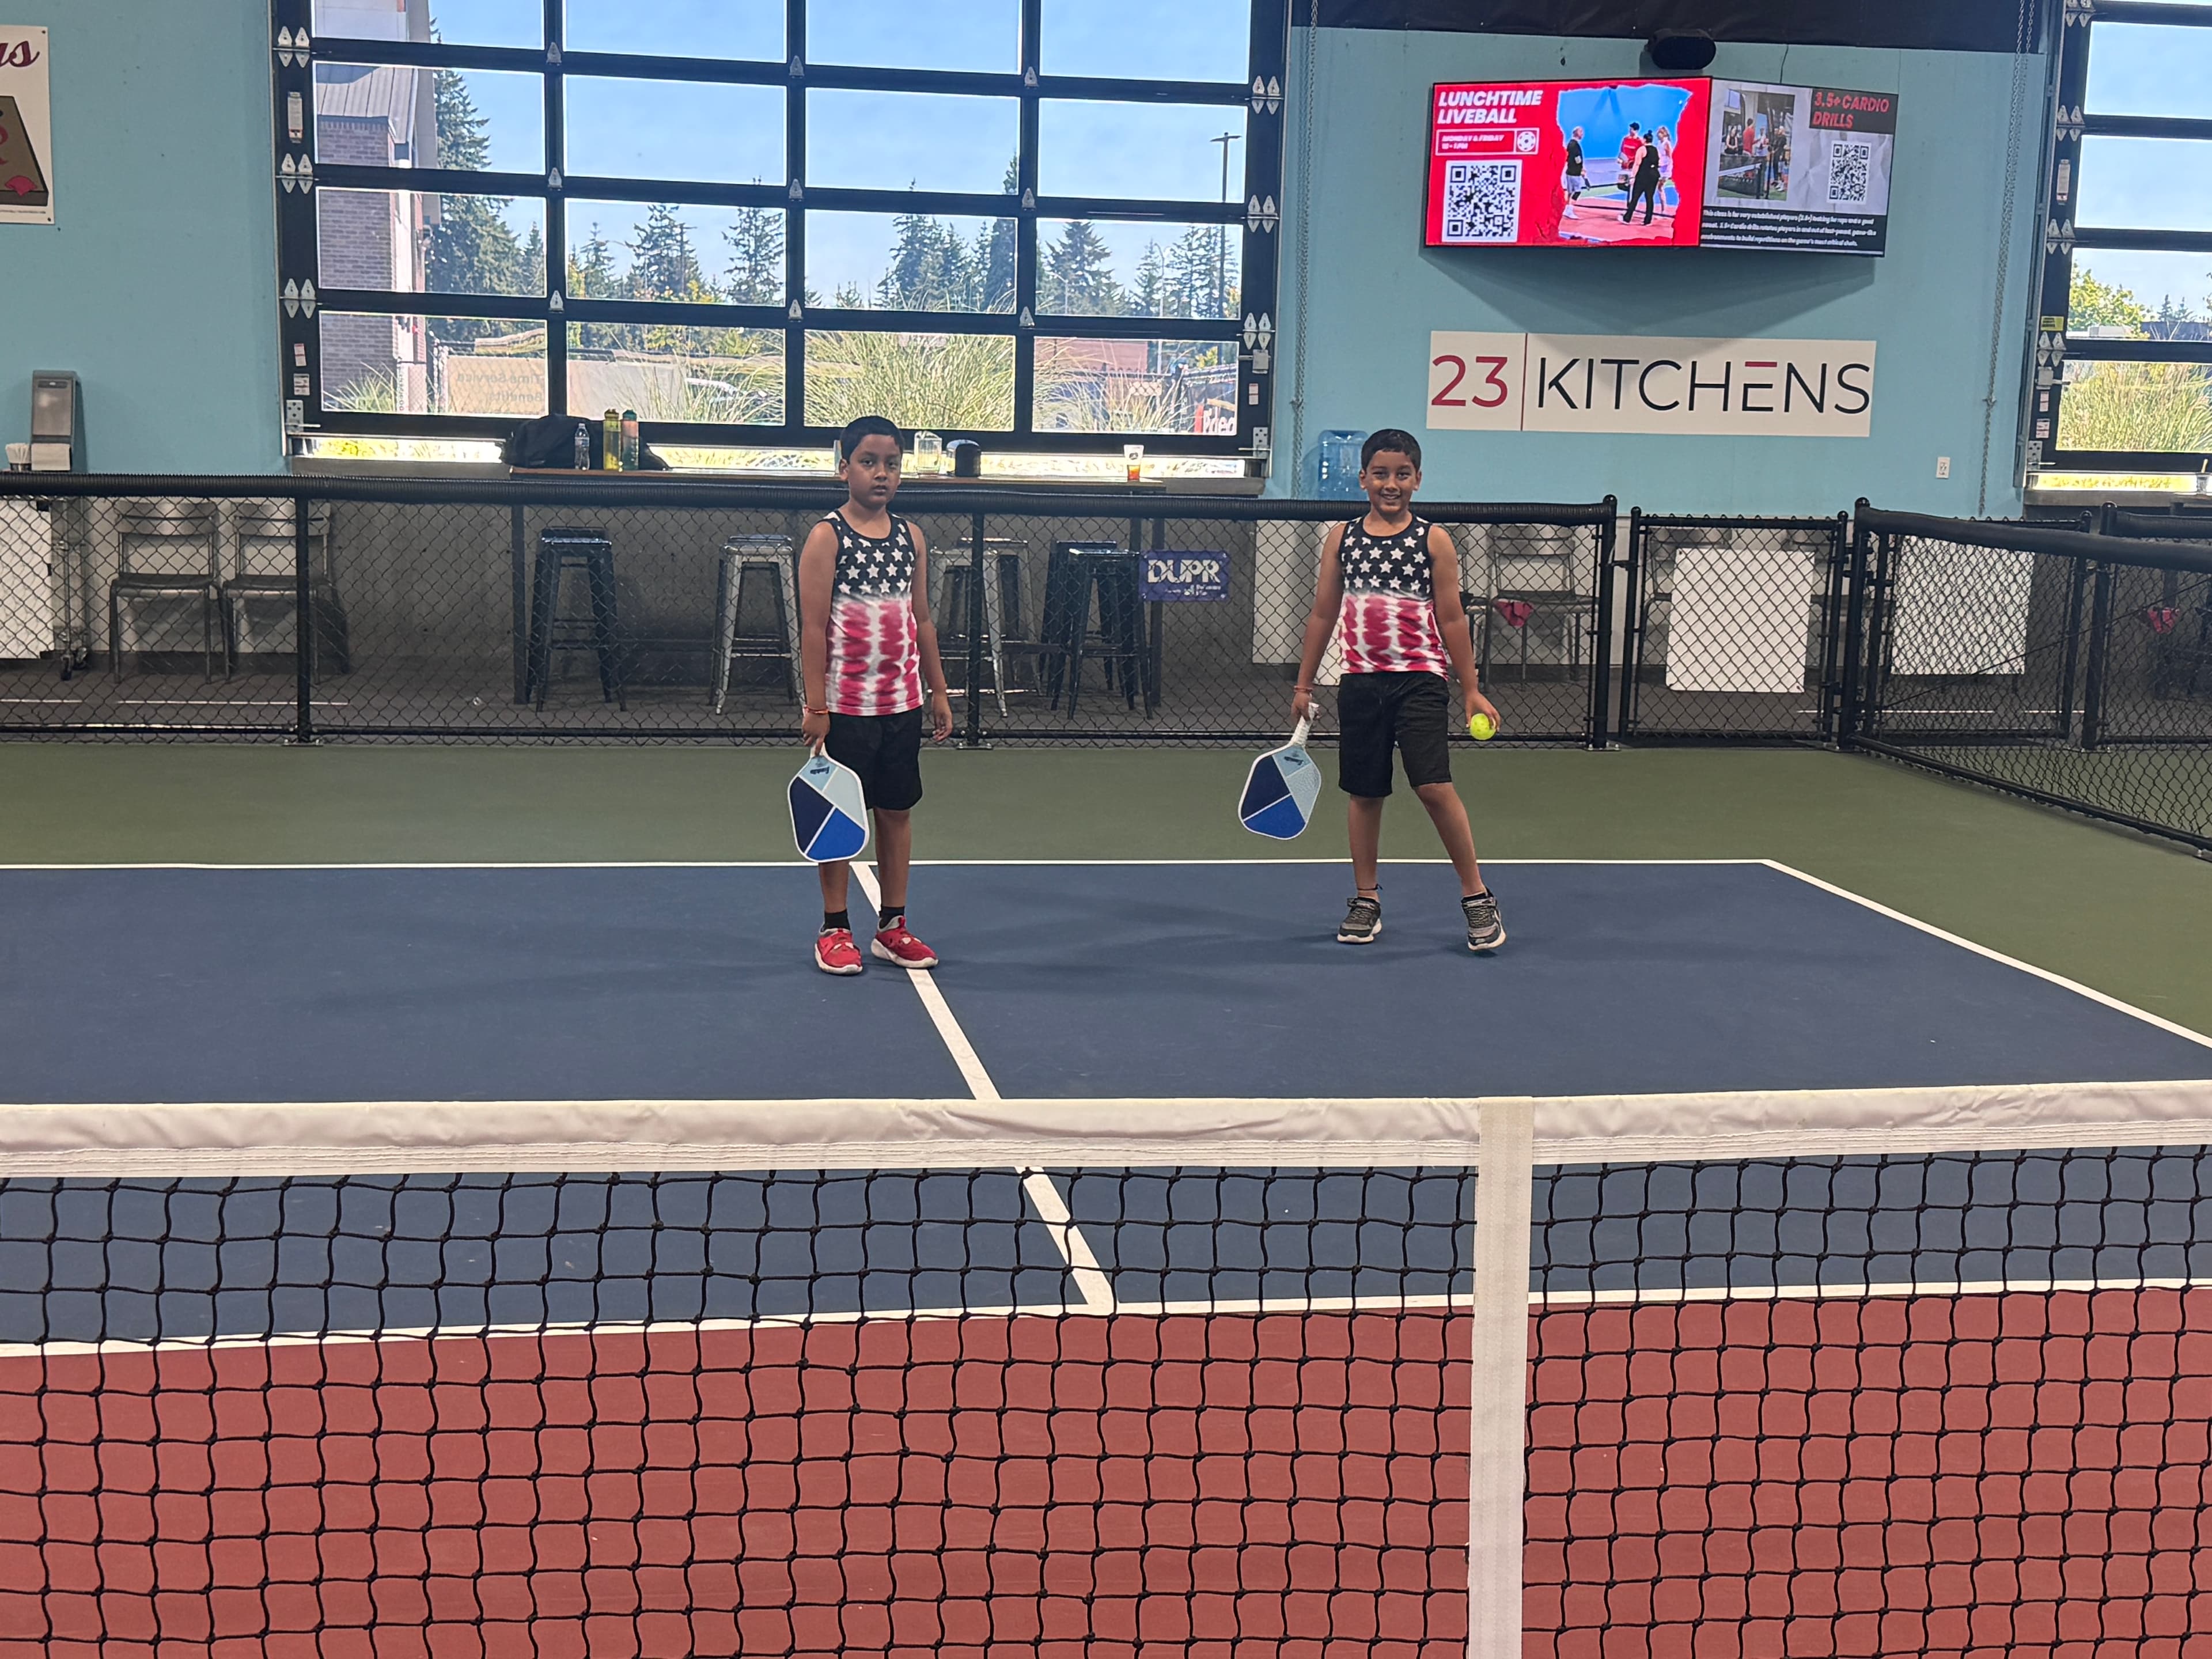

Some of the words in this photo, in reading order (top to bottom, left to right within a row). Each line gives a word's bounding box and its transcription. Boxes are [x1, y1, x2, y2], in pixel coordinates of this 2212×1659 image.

[1438, 90, 1544, 107] LUNCHTIME
[1815, 92, 1841, 108] 3.5+
[1842, 94, 1889, 112] CARDIO
[1437, 108, 1517, 124] LIVEBALL
[1812, 111, 1854, 129] DRILLS
[1431, 355, 1508, 407] 23
[1538, 357, 1870, 414] KITCHENS
[1147, 559, 1221, 583] DUPR
